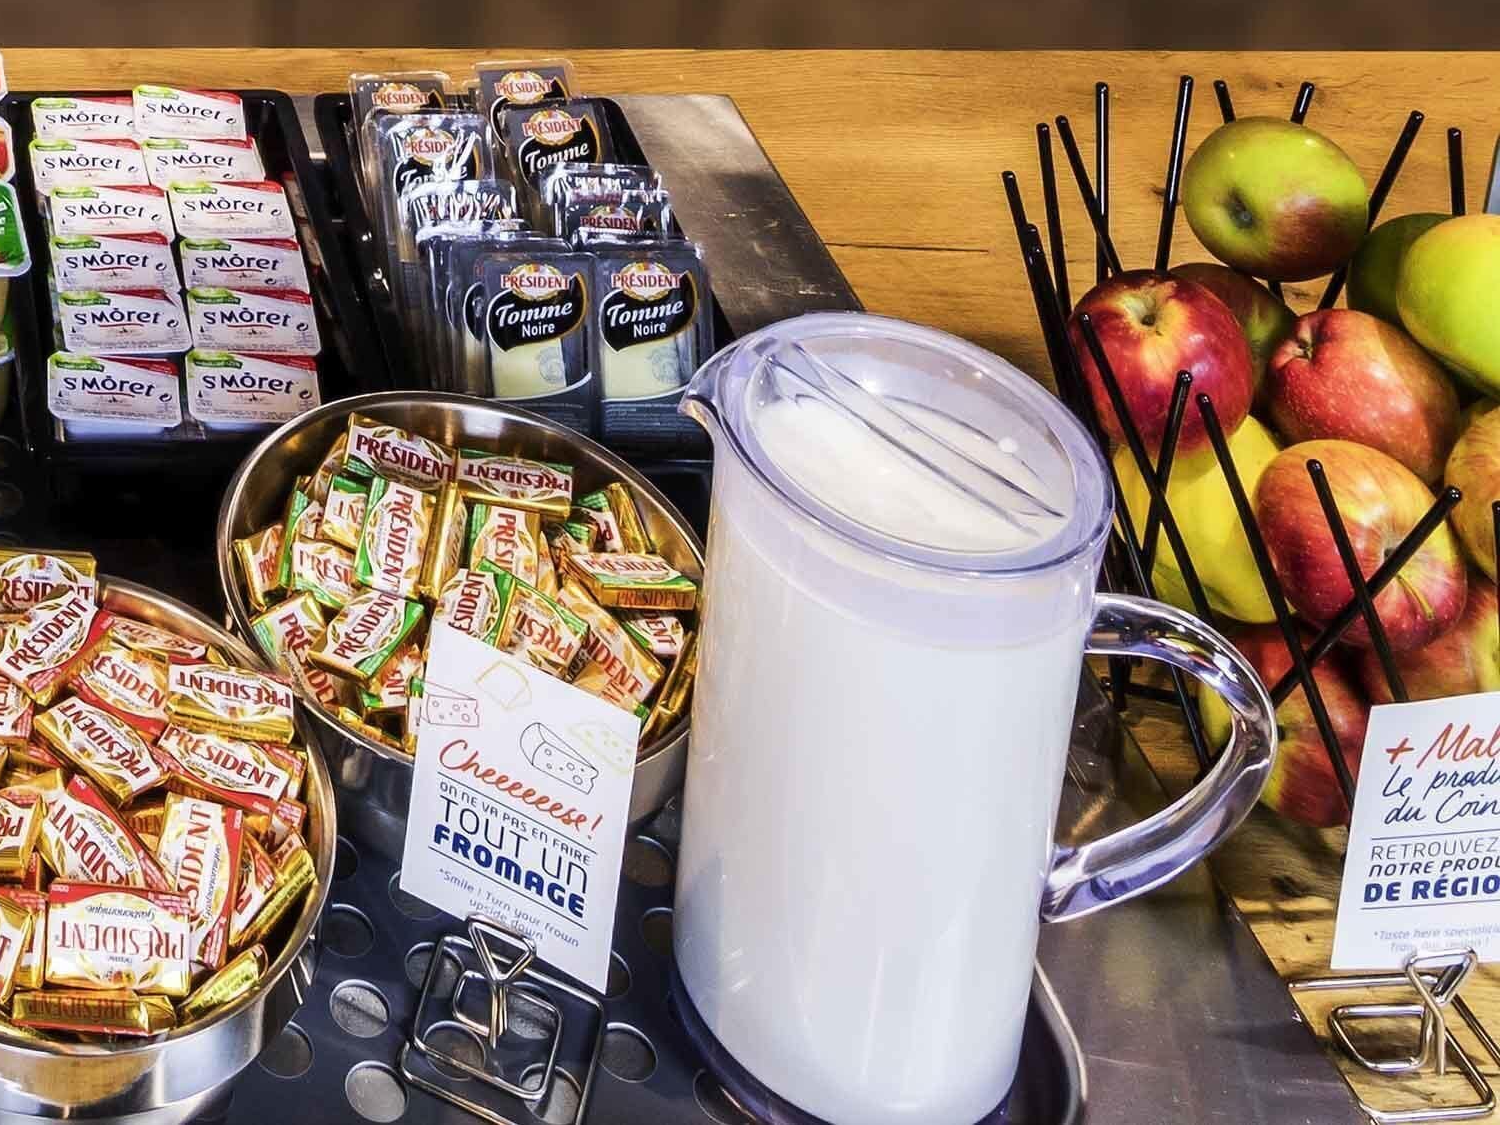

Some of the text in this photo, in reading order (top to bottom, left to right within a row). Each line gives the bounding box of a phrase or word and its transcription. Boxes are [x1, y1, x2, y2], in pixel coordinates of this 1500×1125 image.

[373, 92, 430, 106] PRÉSIDENT
[496, 80, 553, 95] PRÉSIDENT
[522, 118, 582, 136] PRÉSIDENT
[524, 143, 589, 173] Tomme
[502, 273, 569, 288] PRÉSIDENT
[612, 273, 680, 288] PRÉSIDENT
[496, 302, 572, 327] Tomme
[607, 300, 684, 326] Tomme
[522, 322, 555, 337] Noire
[633, 322, 666, 338] Noire
[356, 434, 456, 481] PRÉSIDENT
[467, 464, 570, 492] PRÉSIDENT
[5, 597, 88, 671] PRÉSIDENT
[334, 592, 399, 660] PRÉSIDENT
[177, 672, 291, 709] PRÉSIDENT
[59, 702, 150, 779] PRÉSIDENT
[163, 726, 280, 789] PRÉSIDENT
[1382, 764, 1412, 797] Le
[1384, 789, 1500, 825] du Coin
[462, 790, 478, 808] NE
[482, 799, 498, 818] VA
[503, 810, 527, 832] PAS
[531, 825, 548, 842] EN
[553, 834, 591, 865] FAIRE
[440, 795, 587, 894] TOUT UN
[1371, 836, 1499, 860] RETROUVEZ
[434, 823, 586, 919] FROMAGE
[1369, 861, 1434, 877] NOTRE
[1363, 881, 1401, 903] DE
[514, 907, 541, 927] your
[60, 920, 185, 962] PRÉSIDENT
